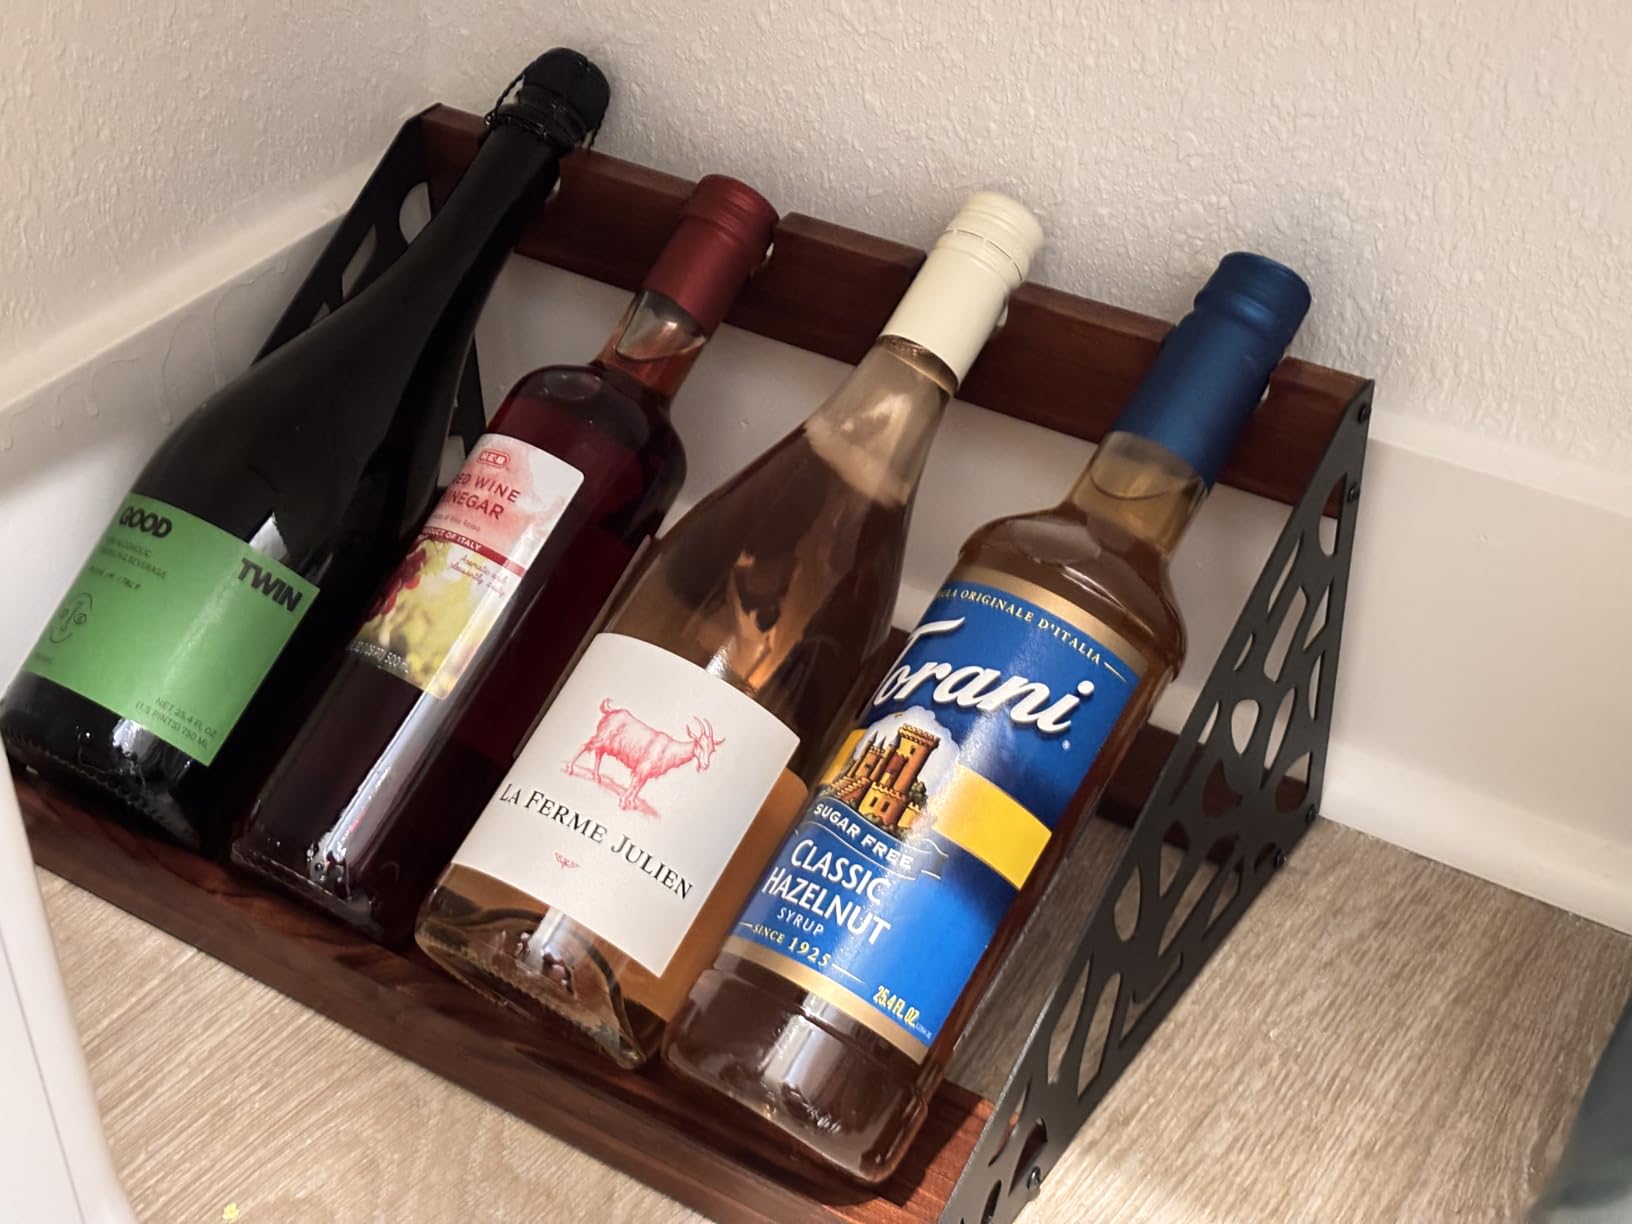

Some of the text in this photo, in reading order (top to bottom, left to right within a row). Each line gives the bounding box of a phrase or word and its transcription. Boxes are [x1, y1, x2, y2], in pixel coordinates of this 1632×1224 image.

[474, 475, 520, 503] WINE
[119, 505, 173, 539] GOOD
[445, 530, 457, 540] OF
[457, 535, 482, 551] ITALY
[238, 556, 303, 613] TWIN
[960, 588, 1101, 666] ORIGINALE D'ITALIA
[384, 651, 402, 668] 500
[155, 697, 175, 712] NET
[182, 725, 198, 741] 750
[499, 782, 695, 902] LA FERME JULIEN
[813, 802, 914, 871] SUGAR FREE
[790, 838, 891, 905] CLASSIC
[761, 865, 892, 945] HAZELNUT
[777, 906, 825, 937] SYRUP
[752, 922, 832, 968] SINCE 1925
[872, 984, 897, 1010] 25.4
